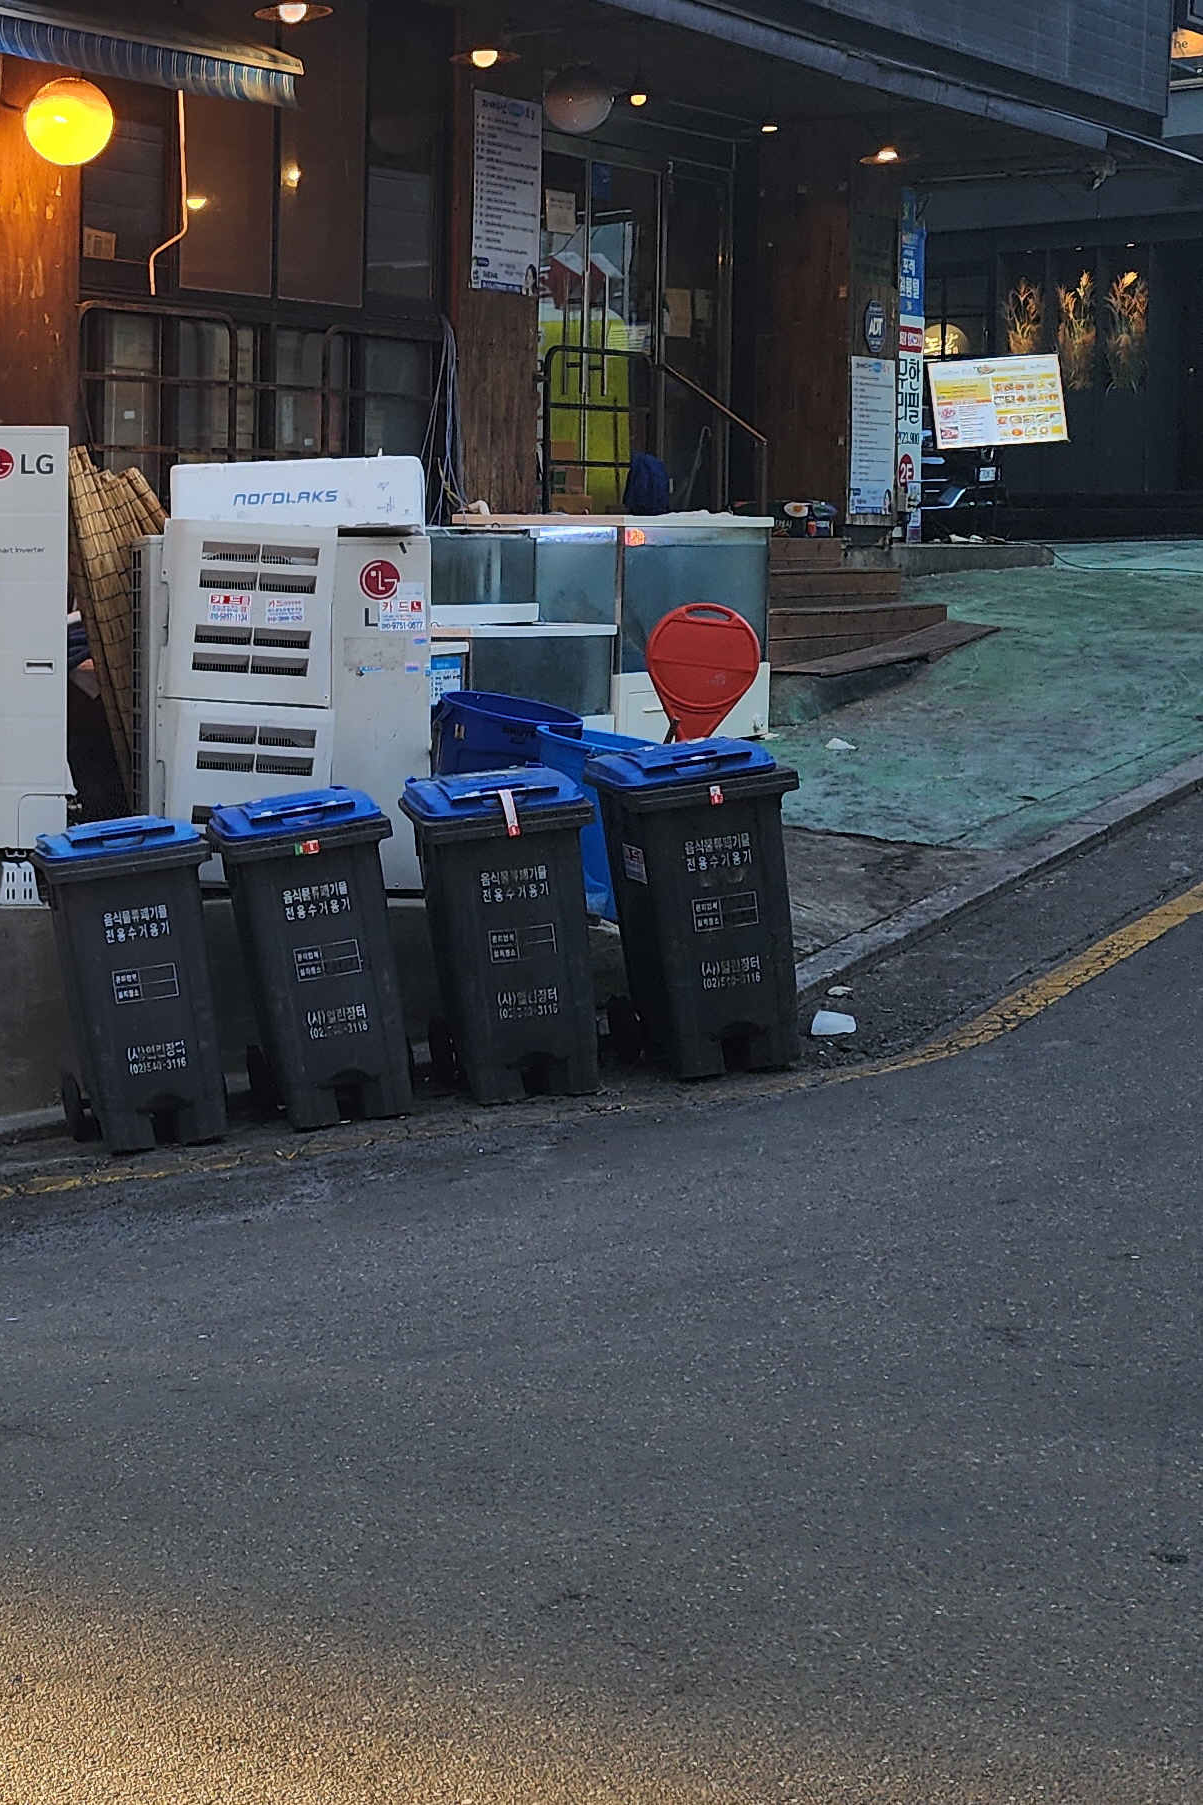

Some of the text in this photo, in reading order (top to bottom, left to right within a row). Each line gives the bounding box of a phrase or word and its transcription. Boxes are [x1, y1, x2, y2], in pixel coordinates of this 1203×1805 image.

[869, 317, 884, 337] ADT
[20, 453, 54, 475] LG
[285, 897, 352, 922] 전용수거용기
[106, 920, 171, 944] 전용수거용기
